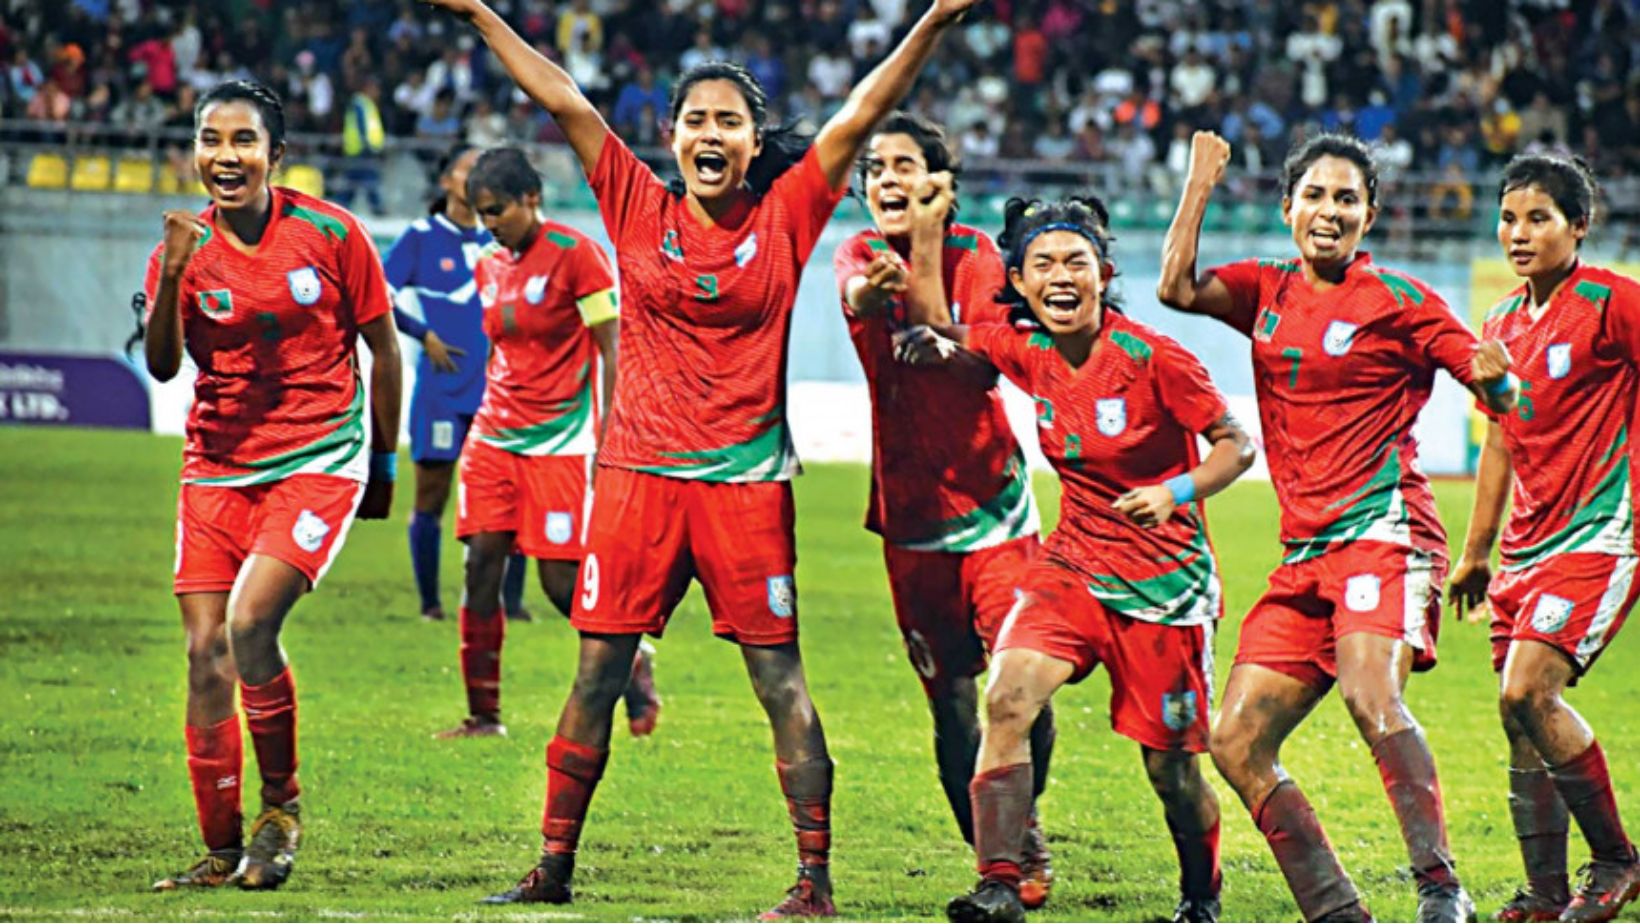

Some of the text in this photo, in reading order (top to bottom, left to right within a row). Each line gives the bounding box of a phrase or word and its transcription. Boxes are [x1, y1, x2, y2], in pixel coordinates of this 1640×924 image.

[695, 273, 718, 303] 9
[1282, 347, 1302, 389] 7
[12, 392, 70, 420] LTD.
[582, 553, 600, 611] 9
